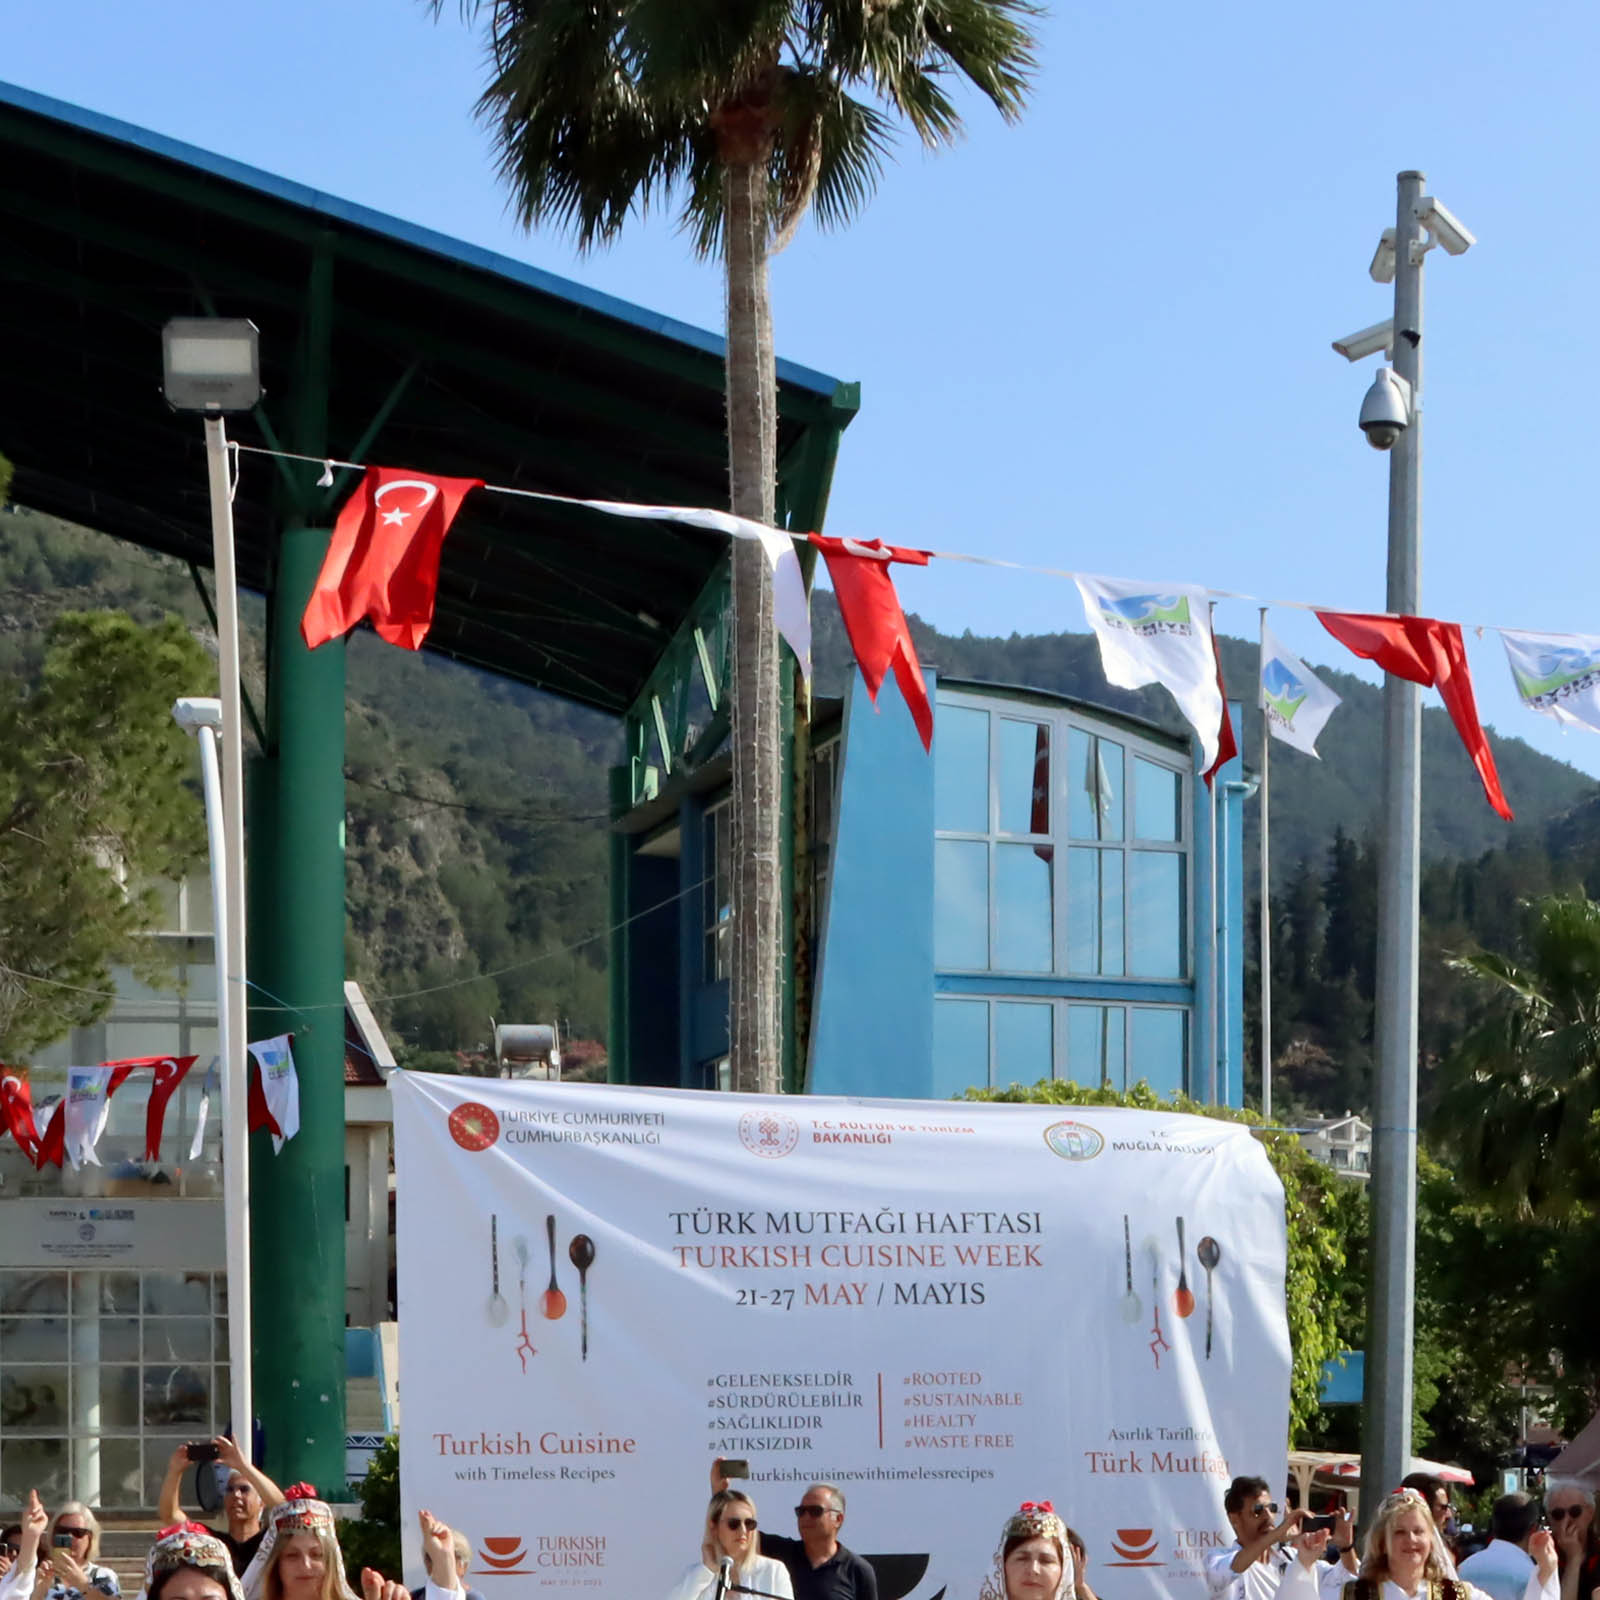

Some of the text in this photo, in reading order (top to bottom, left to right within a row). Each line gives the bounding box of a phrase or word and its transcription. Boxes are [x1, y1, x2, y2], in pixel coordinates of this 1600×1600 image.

[506, 1129, 661, 1146] CUMHURBAŞKANLIĞI
[813, 1131, 892, 1145] BAKANLIĞI
[1112, 1139, 1162, 1152] MUĞLA
[669, 1206, 1043, 1235] TÜRK MUTFAĞI HAFTASI
[673, 1244, 1044, 1268] TURKISH CUISINE WEEK
[735, 1287, 796, 1311] 21-27
[804, 1282, 869, 1306] MAY
[894, 1282, 986, 1306] MAYIS
[707, 1370, 854, 1388] #GELENEKSELDİR
[903, 1372, 982, 1386] #ROOTED
[707, 1391, 864, 1409] #SÜRDÜRÜLEBİLİR
[904, 1393, 1024, 1407] #SUSTAINABLE
[708, 1413, 824, 1430] #SAĞLIKLIDIR
[904, 1414, 977, 1429] #HEALTY
[433, 1432, 636, 1456] Turkish Cuisine
[708, 1436, 813, 1451] #ATIKSIZDIR
[905, 1434, 1015, 1449] #WASTE FREE
[1084, 1451, 1144, 1474] Türk
[455, 1466, 616, 1483] with Timeless Recipes
[536, 1536, 607, 1551] TURKISH
[1174, 1527, 1226, 1548] TÜRK
[536, 1552, 605, 1568] CUISINE
